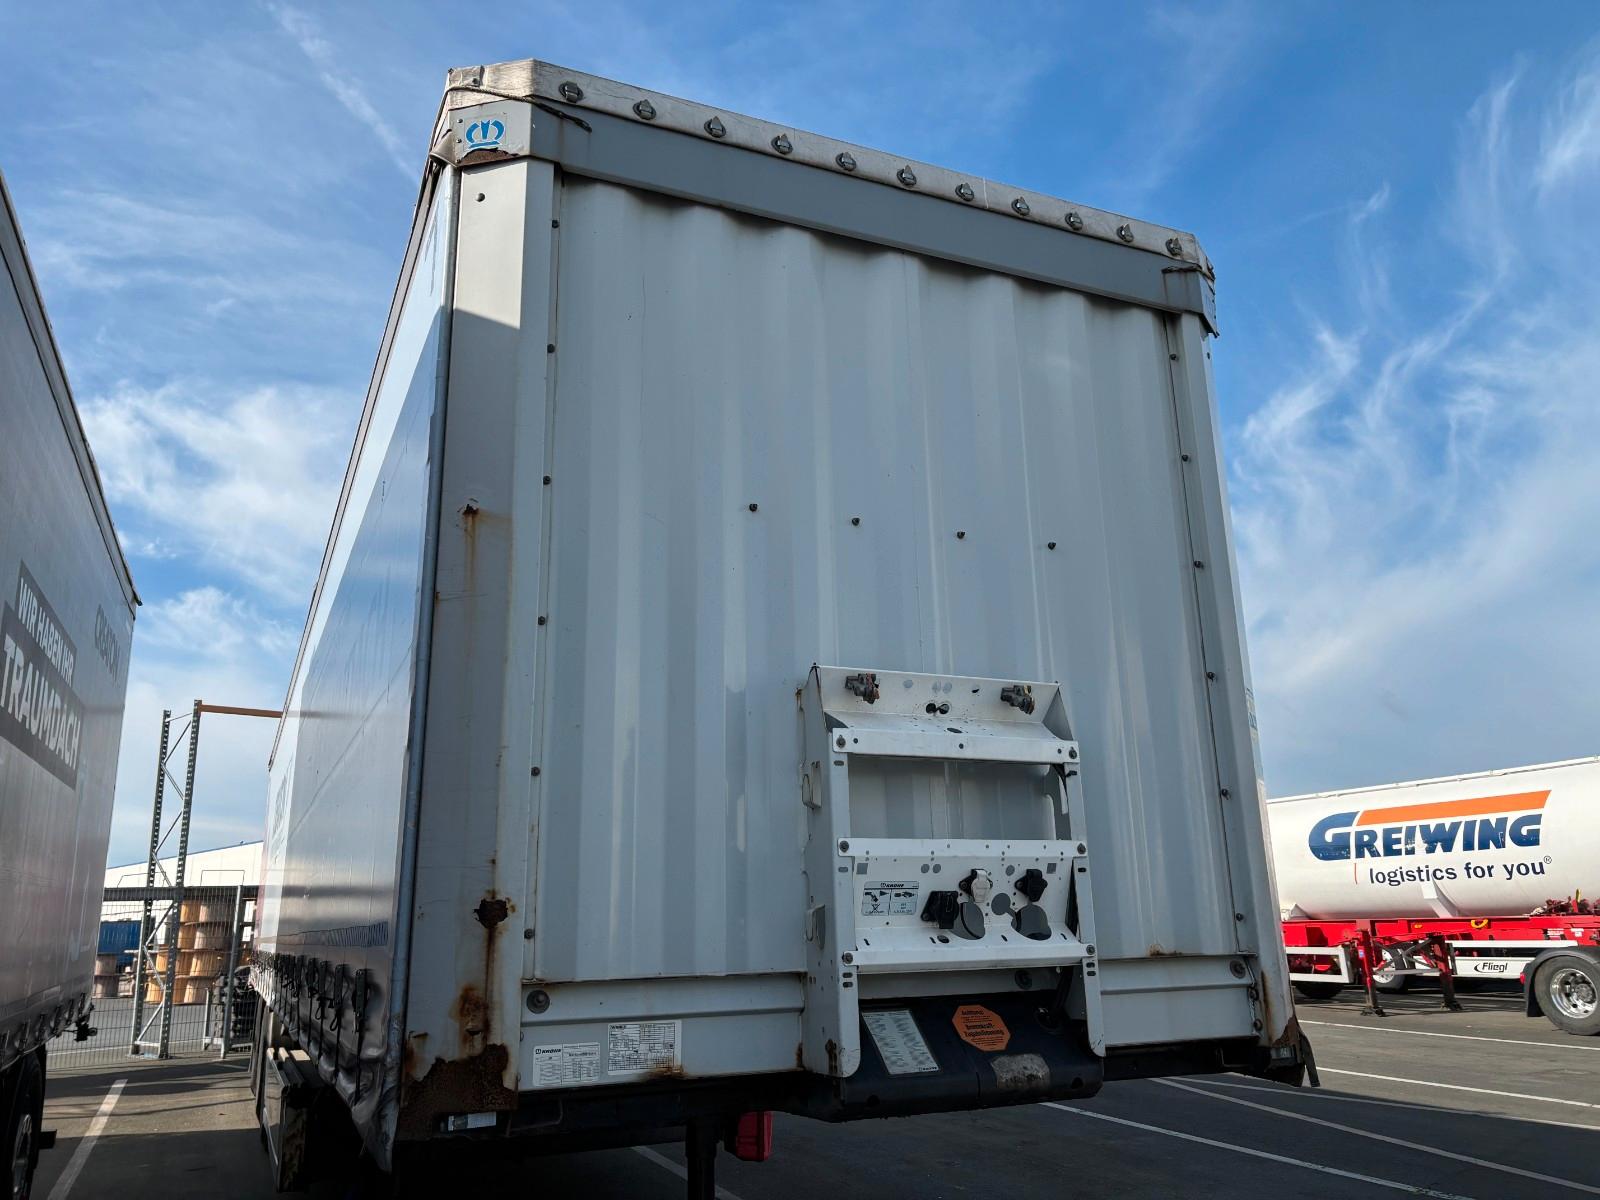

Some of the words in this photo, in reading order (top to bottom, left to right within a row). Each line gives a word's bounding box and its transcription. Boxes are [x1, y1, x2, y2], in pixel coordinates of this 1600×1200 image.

[18, 577, 38, 638] WIR
[36, 606, 64, 672] HABEN
[61, 644, 75, 688] IHR
[0, 632, 81, 771] TRAUMDACH
[1308, 811, 1543, 861] GREIWING
[1369, 864, 1458, 887] logistics
[1464, 861, 1495, 879] for
[1481, 962, 1509, 974] Fliegl
